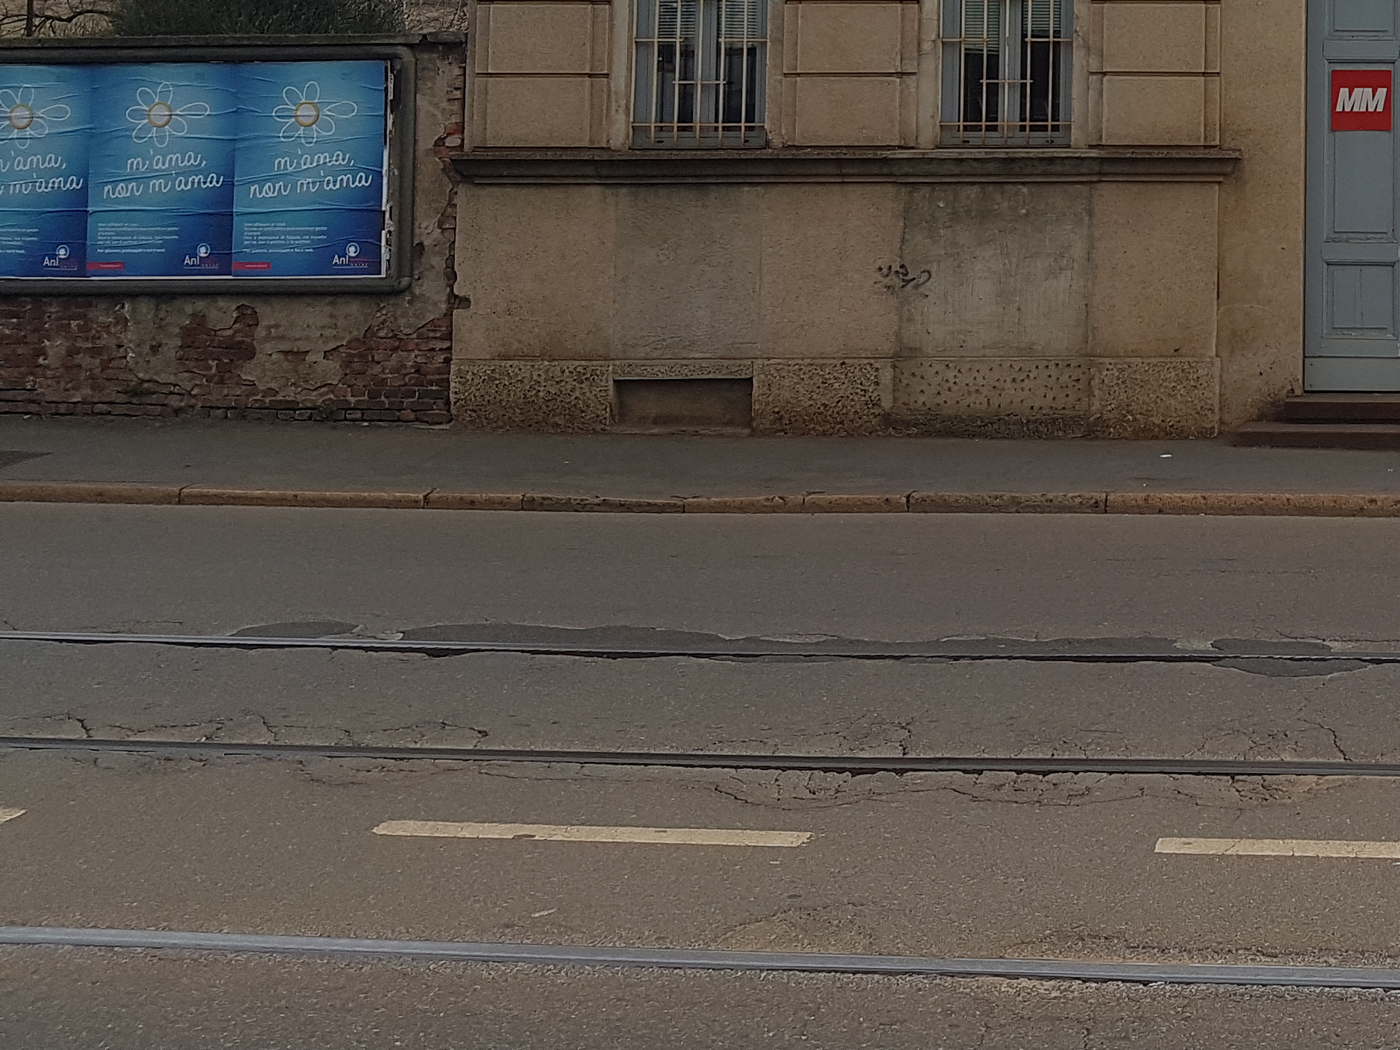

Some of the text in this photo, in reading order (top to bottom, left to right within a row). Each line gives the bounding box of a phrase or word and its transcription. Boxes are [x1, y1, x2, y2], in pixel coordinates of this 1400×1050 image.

[1335, 88, 1388, 112] MM
[126, 149, 207, 172] m'ama,
[274, 148, 355, 172] m'ama,
[103, 180, 144, 200] non
[249, 169, 373, 199] non m'ama
